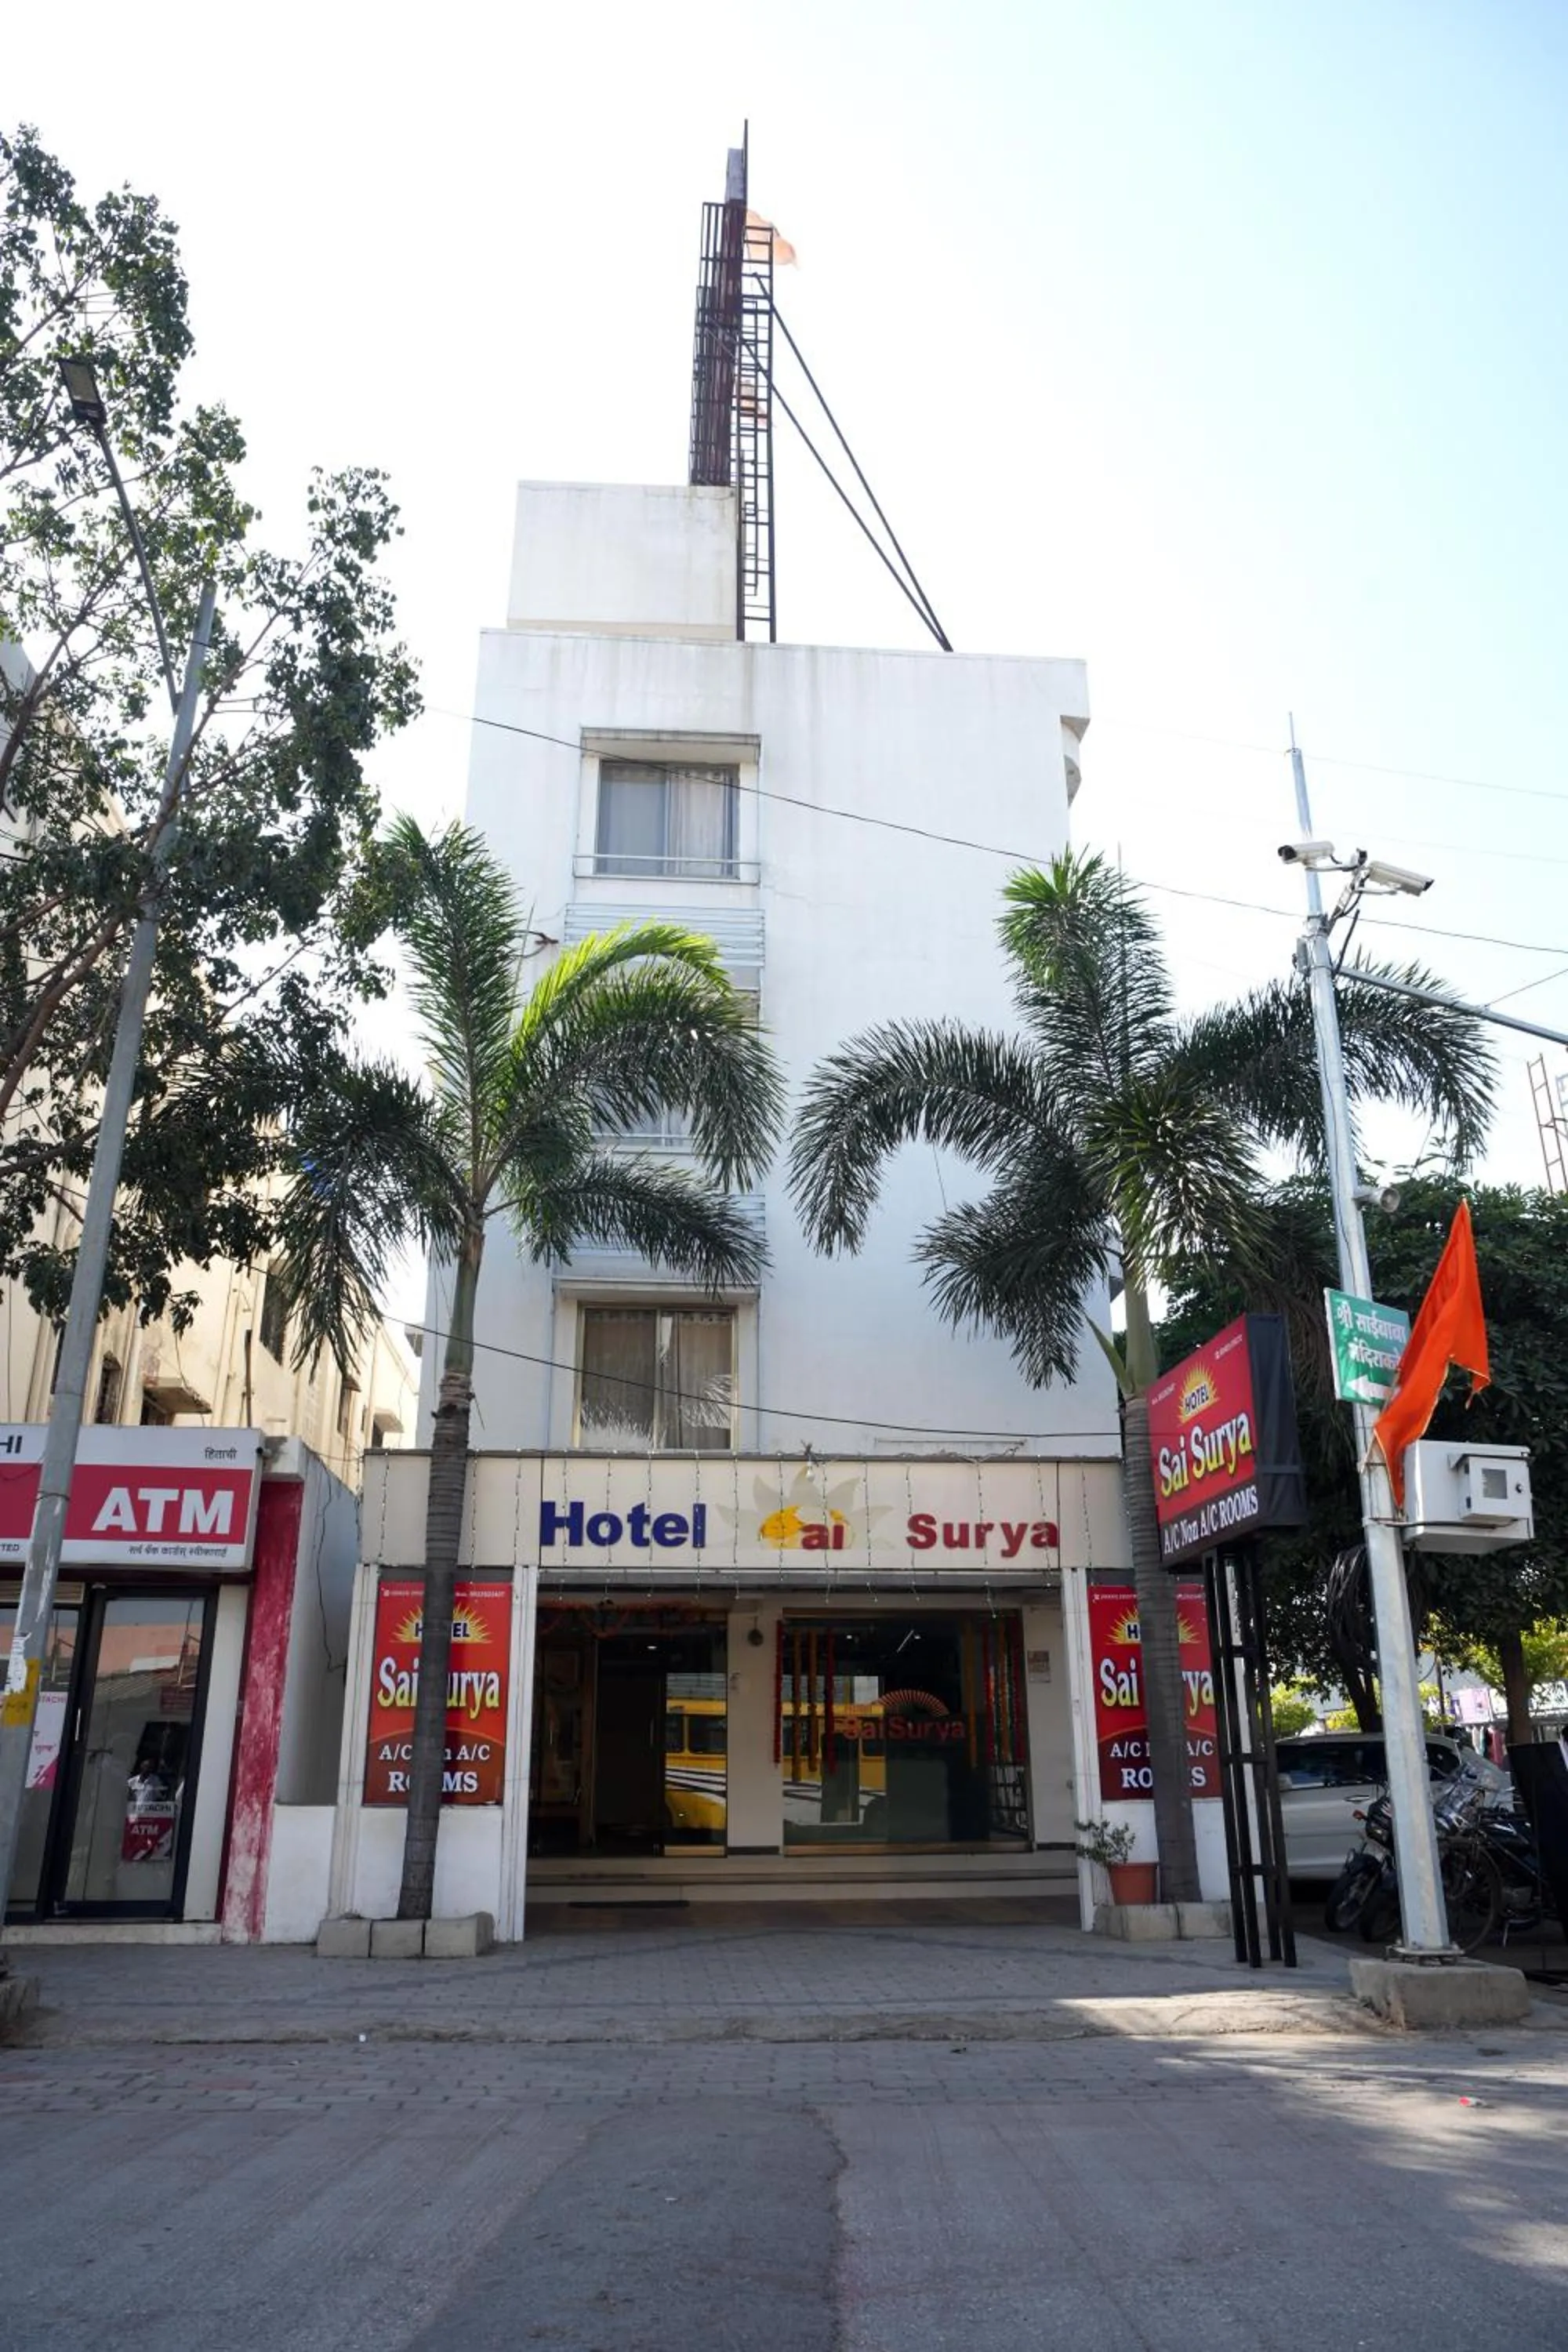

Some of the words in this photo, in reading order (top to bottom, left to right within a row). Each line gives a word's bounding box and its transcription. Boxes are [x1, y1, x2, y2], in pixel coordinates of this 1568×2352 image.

[1184, 1385, 1210, 1411] HOTEL
[1159, 1436, 1189, 1497] Sai
[1191, 1412, 1252, 1479] Surya
[91, 1486, 234, 1535] ATM
[1164, 1523, 1179, 1555] A/C
[1181, 1519, 1199, 1546] Non
[1200, 1504, 1218, 1537] A/C
[1219, 1485, 1258, 1528] ROOMS
[539, 1501, 706, 1548] Hotel
[906, 1513, 1060, 1558] Surya
[415, 1621, 470, 1639] HEL
[378, 1656, 419, 1708] Sai
[446, 1671, 499, 1719] urya
[1100, 1657, 1140, 1708] Sai
[844, 1715, 884, 1740] Sai
[889, 1716, 966, 1743] Surya
[379, 1745, 412, 1761] A/C
[456, 1745, 490, 1761] A/C
[1110, 1741, 1142, 1757] A/C
[388, 1770, 478, 1792] RMS
[1121, 1767, 1206, 1788] ROS
[130, 1824, 159, 1835] ATM
